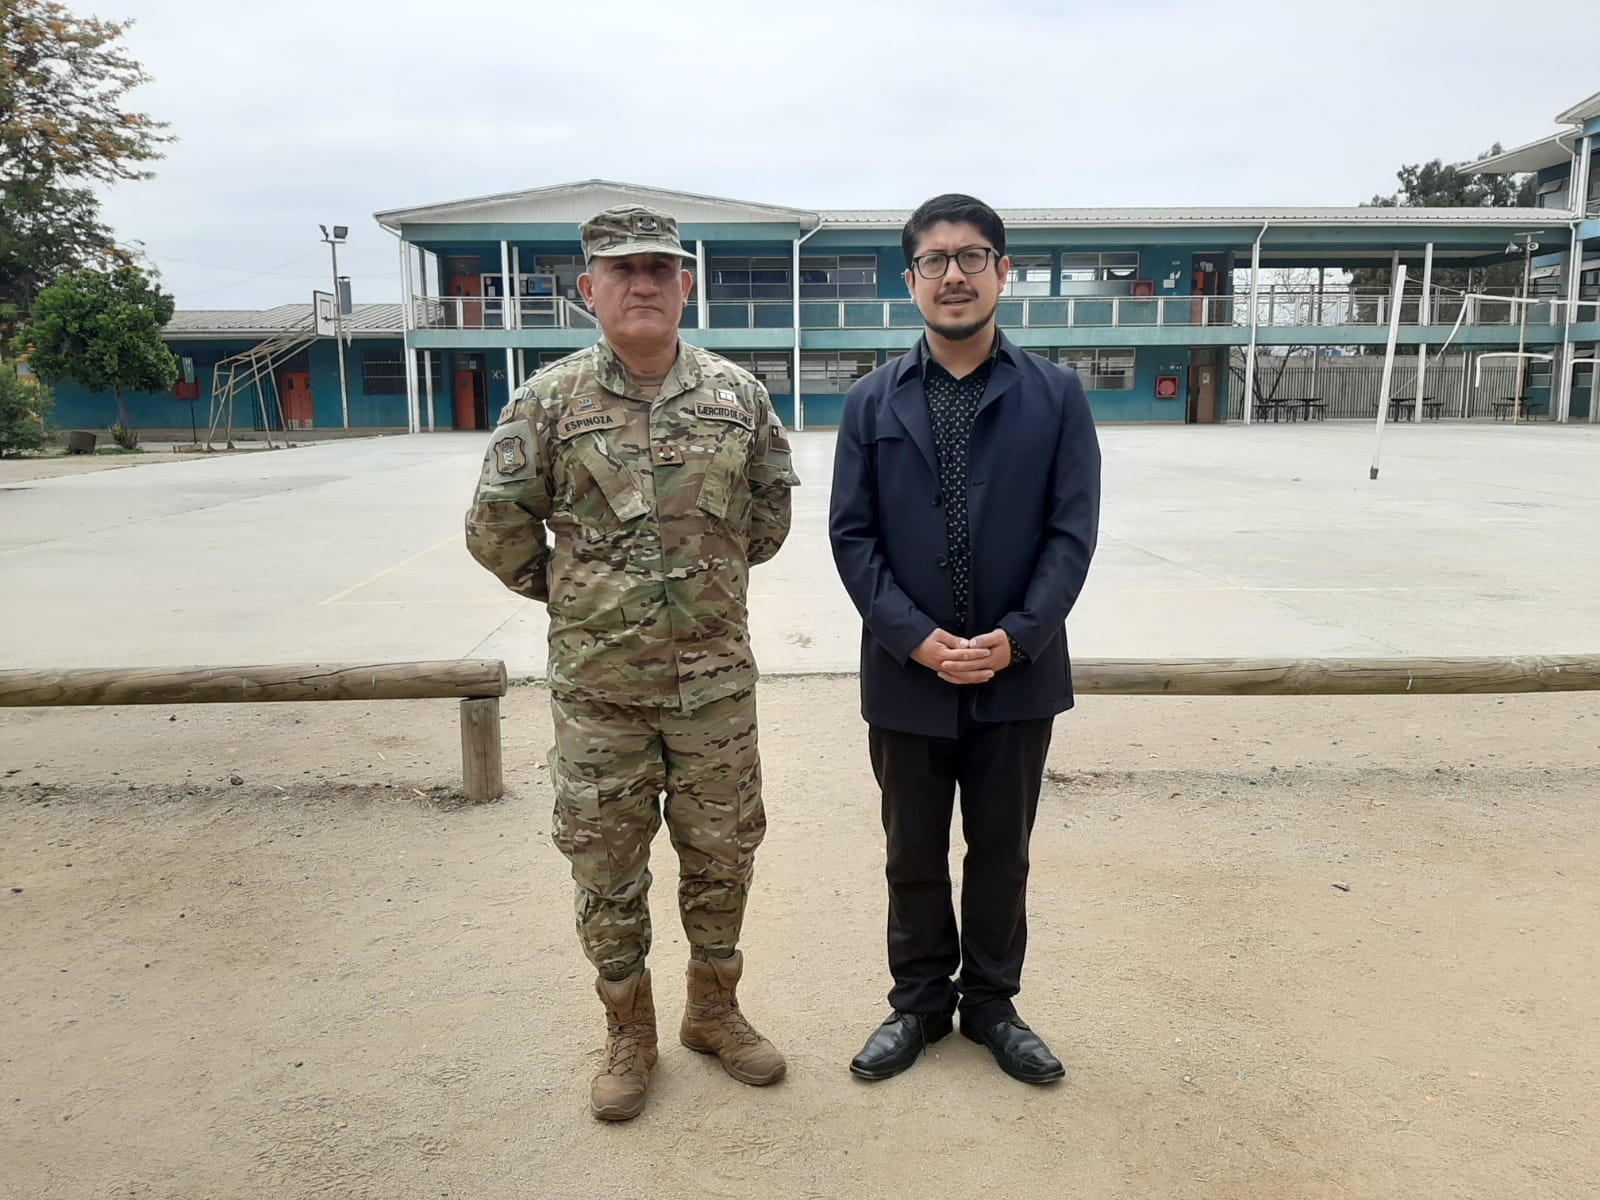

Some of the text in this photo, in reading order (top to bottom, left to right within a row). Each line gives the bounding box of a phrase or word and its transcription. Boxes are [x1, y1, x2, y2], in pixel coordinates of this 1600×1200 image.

[697, 405, 730, 417] EJERCITO
[731, 409, 738, 418] DE
[564, 415, 614, 432] ESPINOZA
